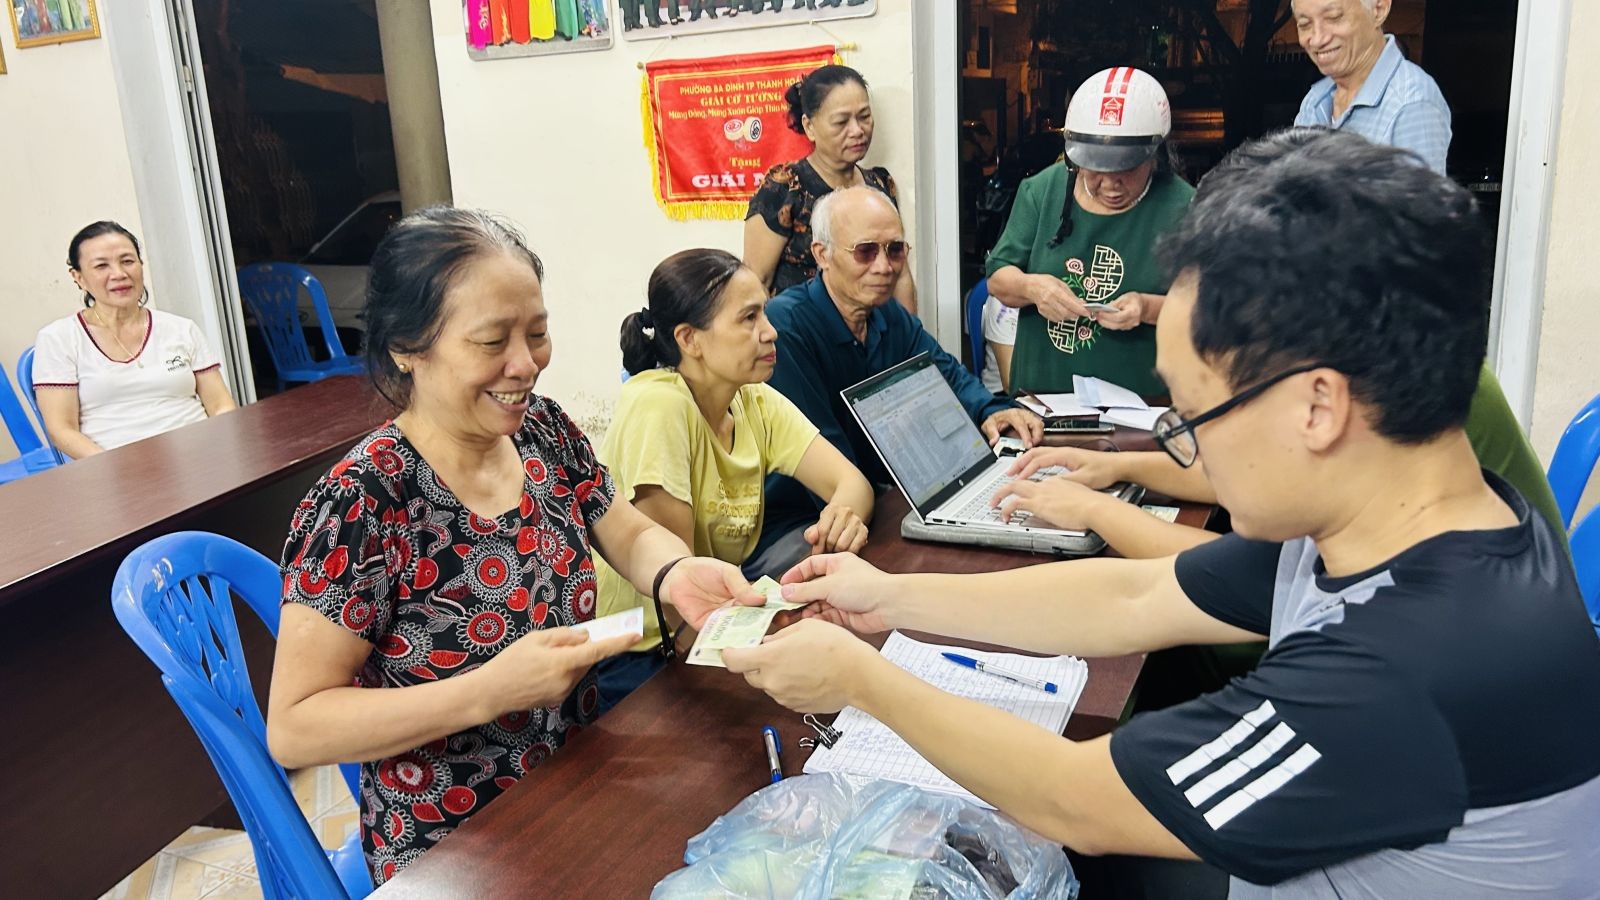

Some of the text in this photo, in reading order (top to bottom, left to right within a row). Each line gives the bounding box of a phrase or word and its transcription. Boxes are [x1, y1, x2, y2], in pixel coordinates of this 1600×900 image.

[746, 81, 754, 90] TP
[756, 78, 783, 89] THANH
[700, 94, 724, 106] GIẢI
[729, 156, 761, 169] Tặng
[692, 171, 746, 188] GIẢI
